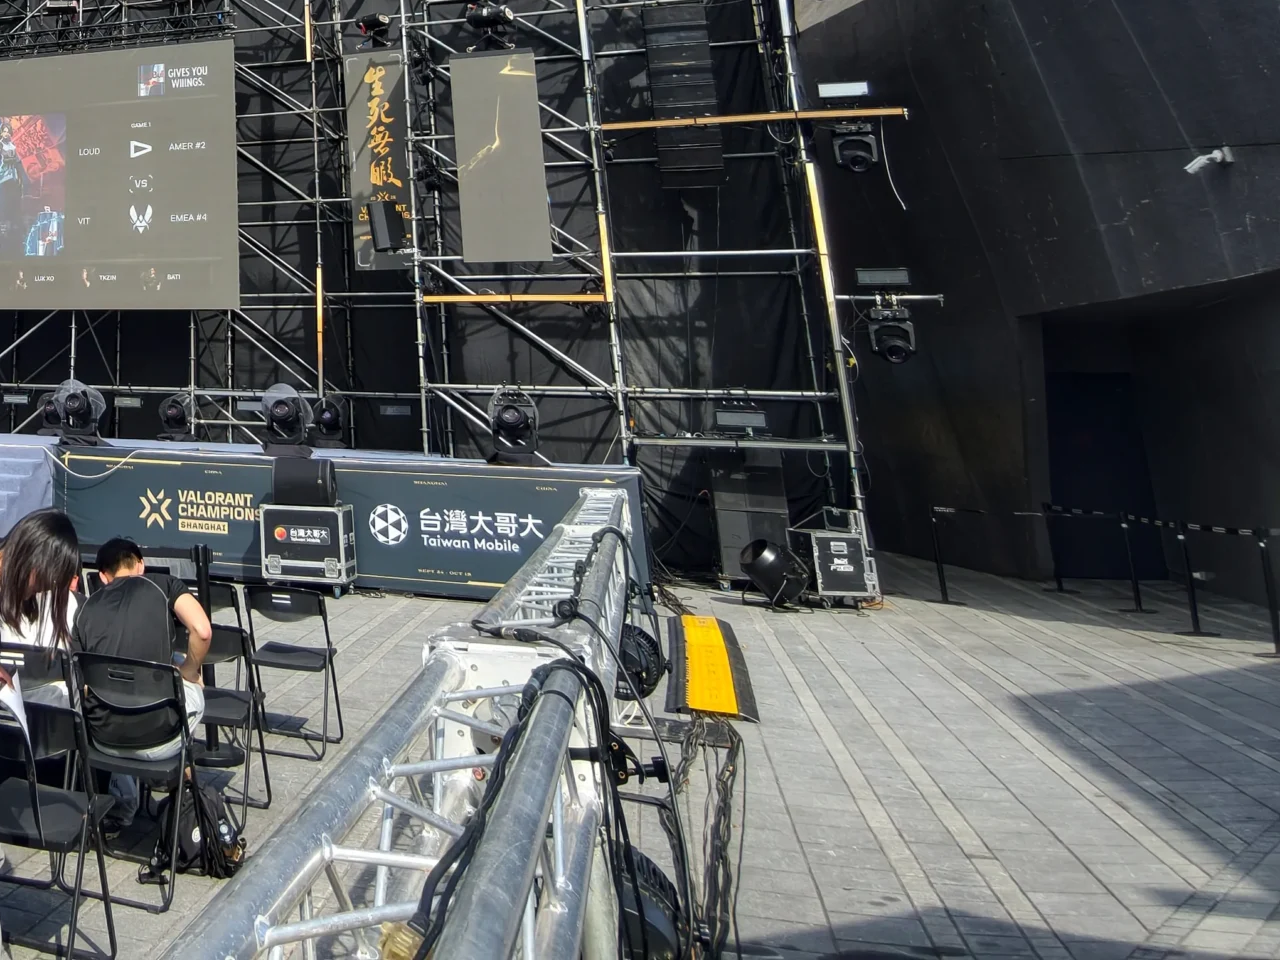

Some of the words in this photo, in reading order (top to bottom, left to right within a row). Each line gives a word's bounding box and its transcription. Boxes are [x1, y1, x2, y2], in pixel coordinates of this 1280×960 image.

[168, 67, 189, 78] GIVES
[191, 66, 208, 76] YOU
[79, 148, 100, 156] LOUD
[169, 142, 193, 151] AMER
[134, 180, 148, 188] VS
[78, 217, 90, 225] VIT
[170, 214, 194, 222] EMEA
[196, 213, 207, 221] #4
[178, 490, 253, 507] VALORANT
[180, 521, 227, 532] SHANGHAI
[419, 507, 545, 540] 台灣大哥大
[290, 528, 328, 539] 台灣大哥大
[421, 534, 470, 549] Taiwan
[474, 539, 520, 553] Mobile
